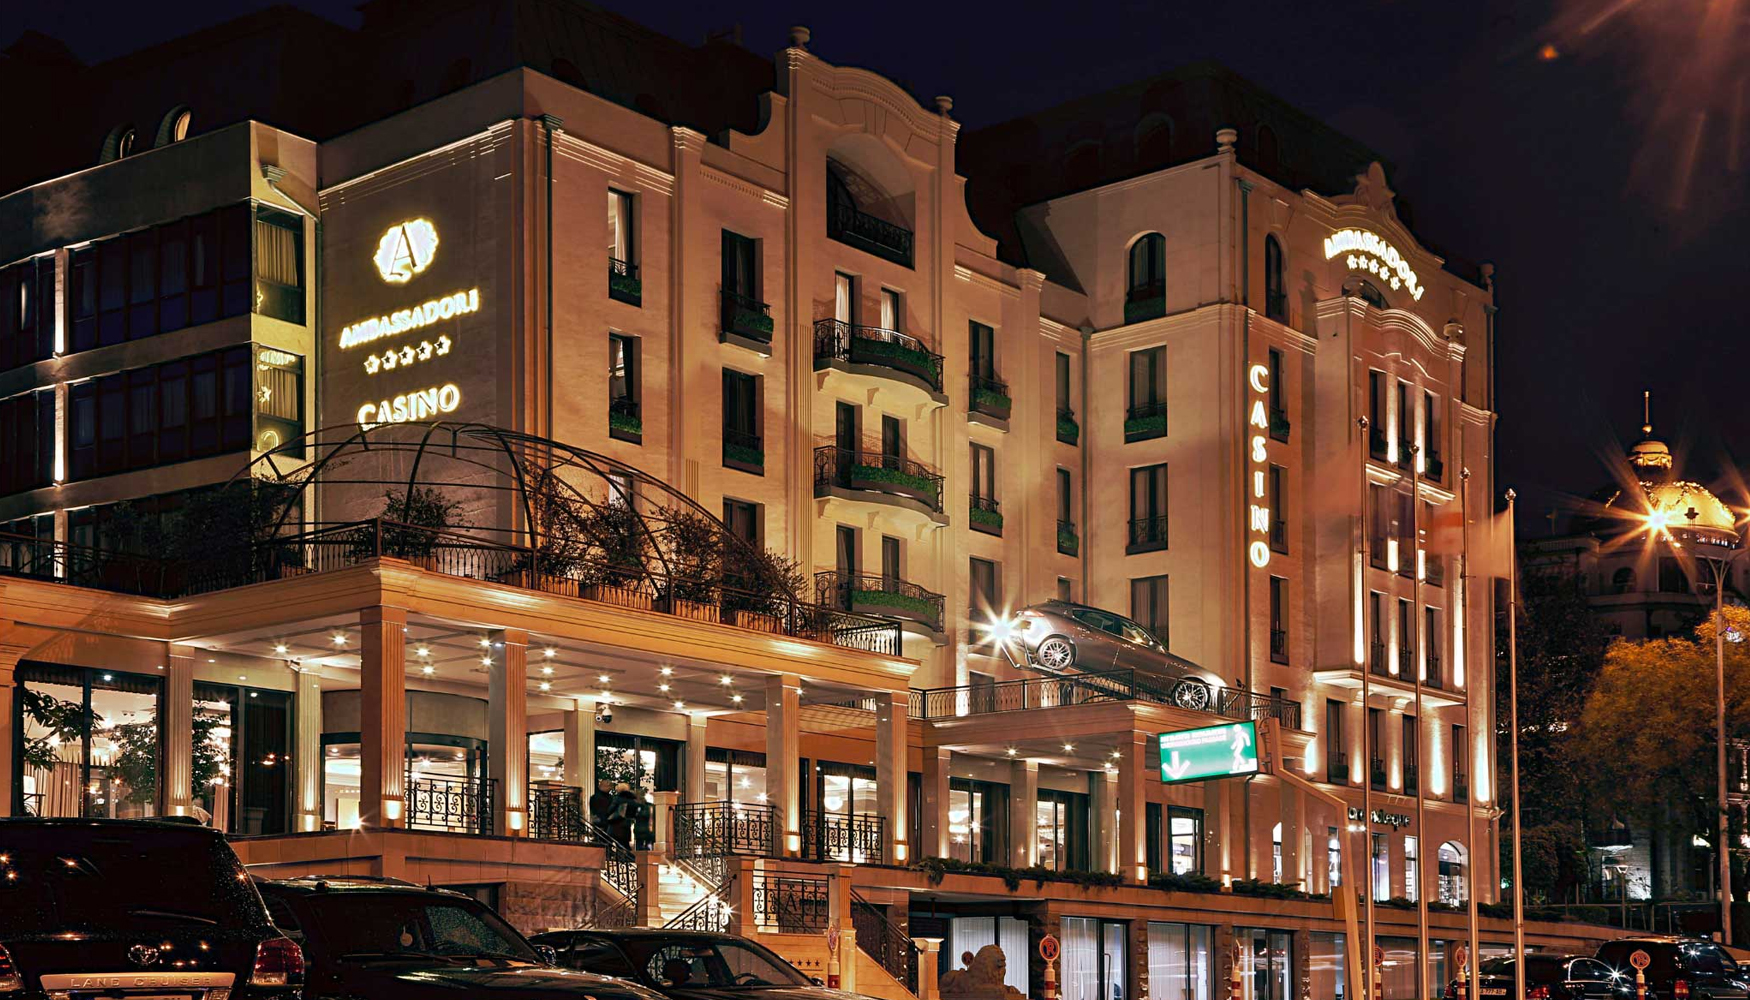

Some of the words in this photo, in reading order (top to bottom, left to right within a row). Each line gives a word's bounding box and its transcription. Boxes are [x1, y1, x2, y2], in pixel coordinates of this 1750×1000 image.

[338, 287, 481, 349] AMBASSADORI
[357, 383, 461, 431] CASINO
[1250, 364, 1270, 568] CASINO
[71, 978, 120, 987] LAND
[133, 975, 211, 986] CRUISER
